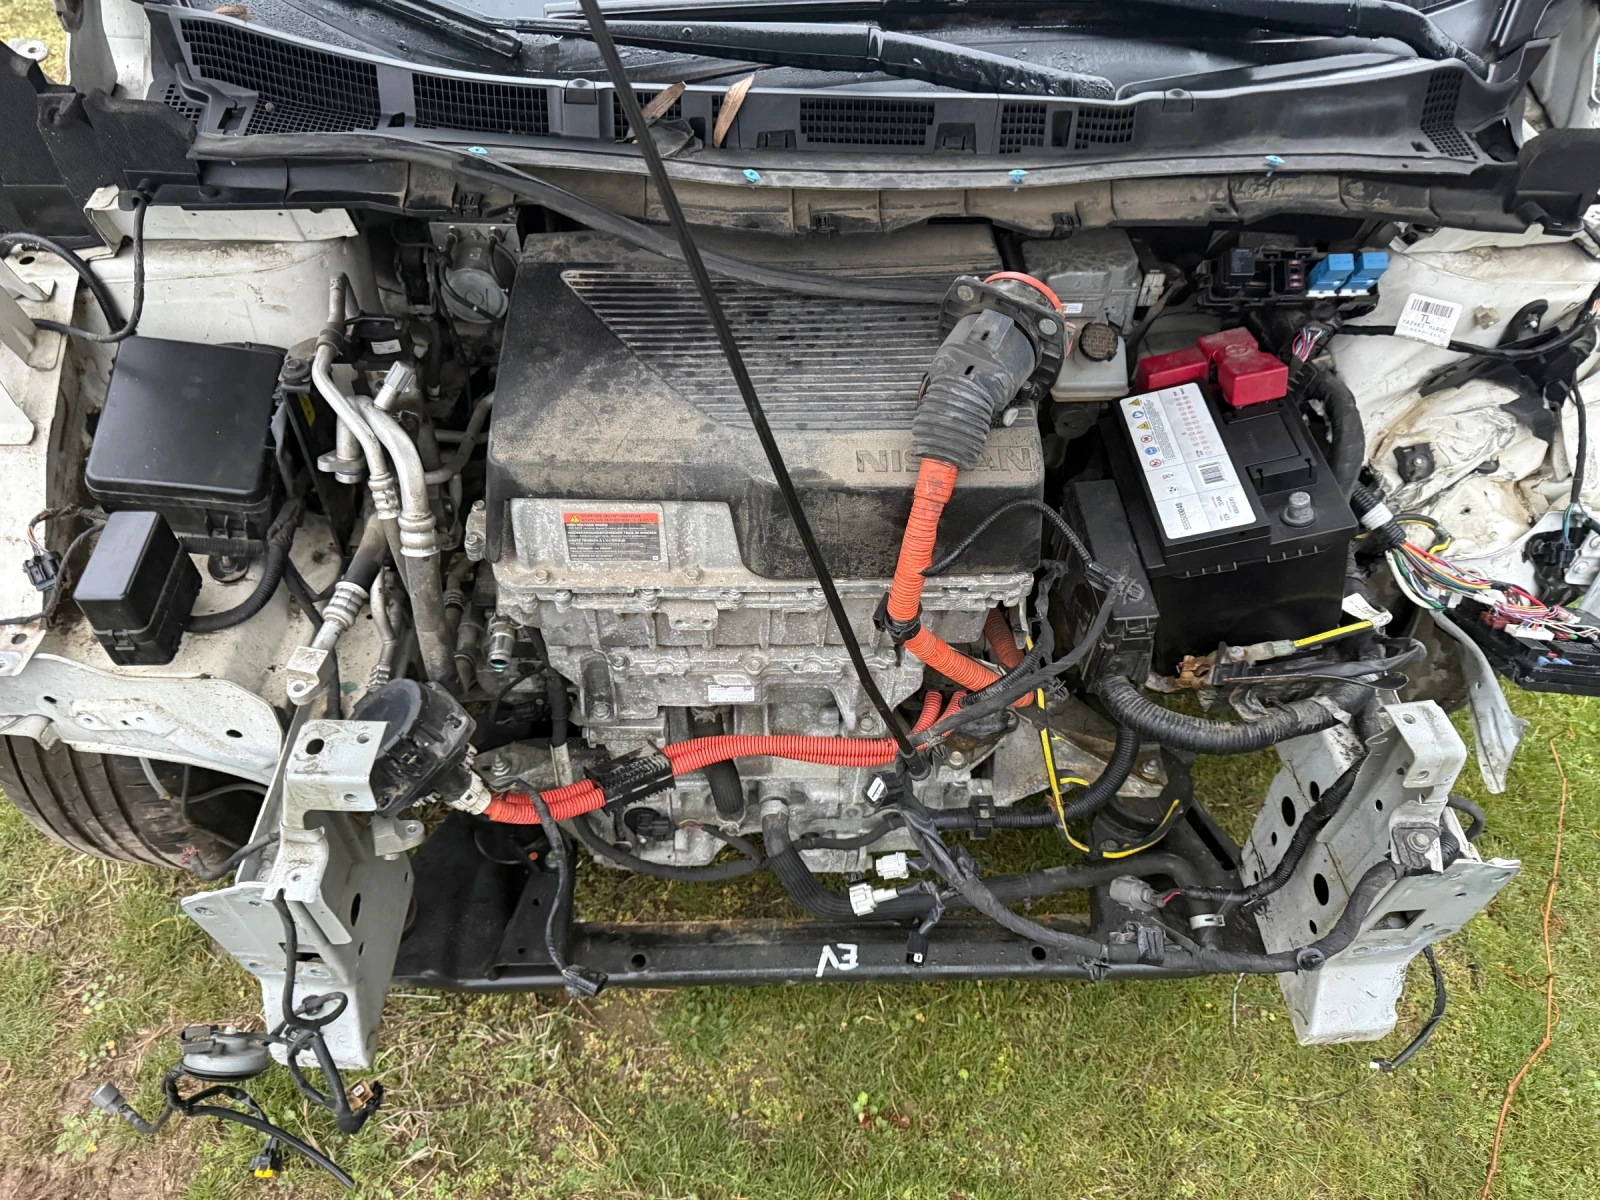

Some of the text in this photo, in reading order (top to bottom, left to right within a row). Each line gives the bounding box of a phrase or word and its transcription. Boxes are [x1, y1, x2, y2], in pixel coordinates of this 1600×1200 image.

[1402, 318, 1425, 329] YAZAKI
[1428, 325, 1448, 334] MAROC
[1421, 314, 1432, 324] TL
[856, 447, 1034, 473] NIAN
[815, 943, 859, 978] EV
